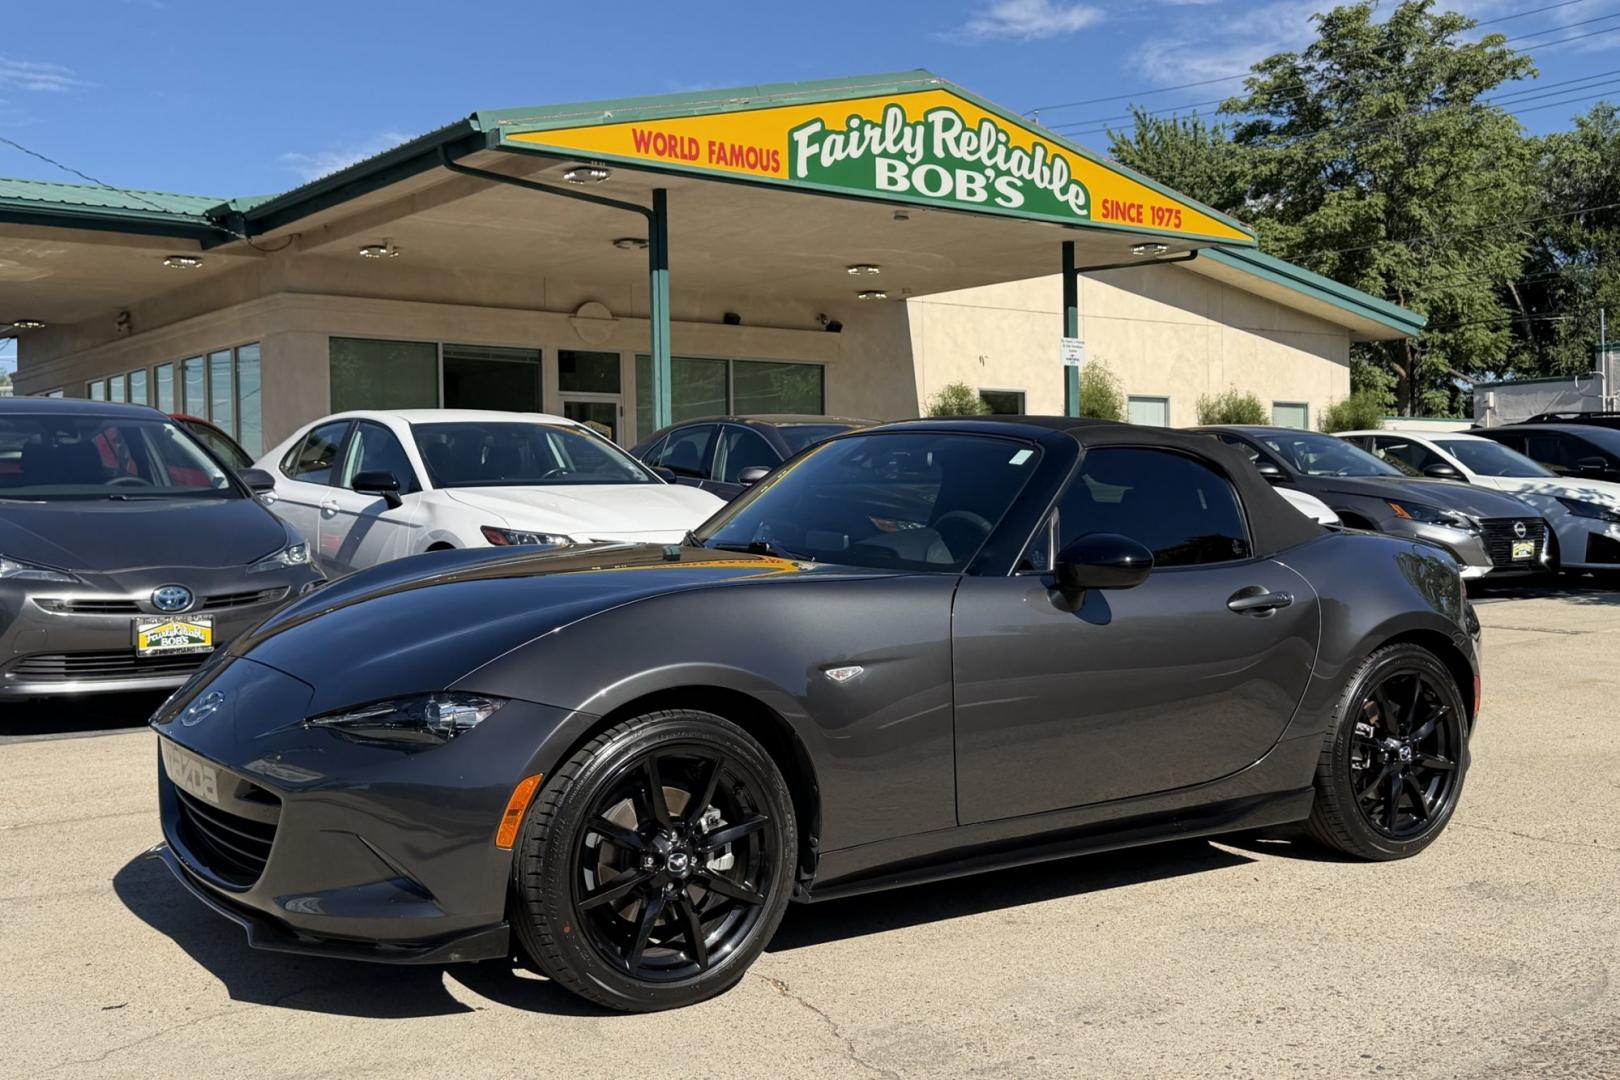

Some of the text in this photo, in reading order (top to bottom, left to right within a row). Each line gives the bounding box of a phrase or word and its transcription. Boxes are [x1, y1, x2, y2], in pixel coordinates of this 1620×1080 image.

[632, 128, 780, 173] WORLD FAMOUS
[793, 107, 1088, 215] Fairly Reliable
[875, 157, 1025, 208] BOB'S
[1101, 198, 1182, 229] SINCE 1975
[161, 636, 190, 646] BOB'S
